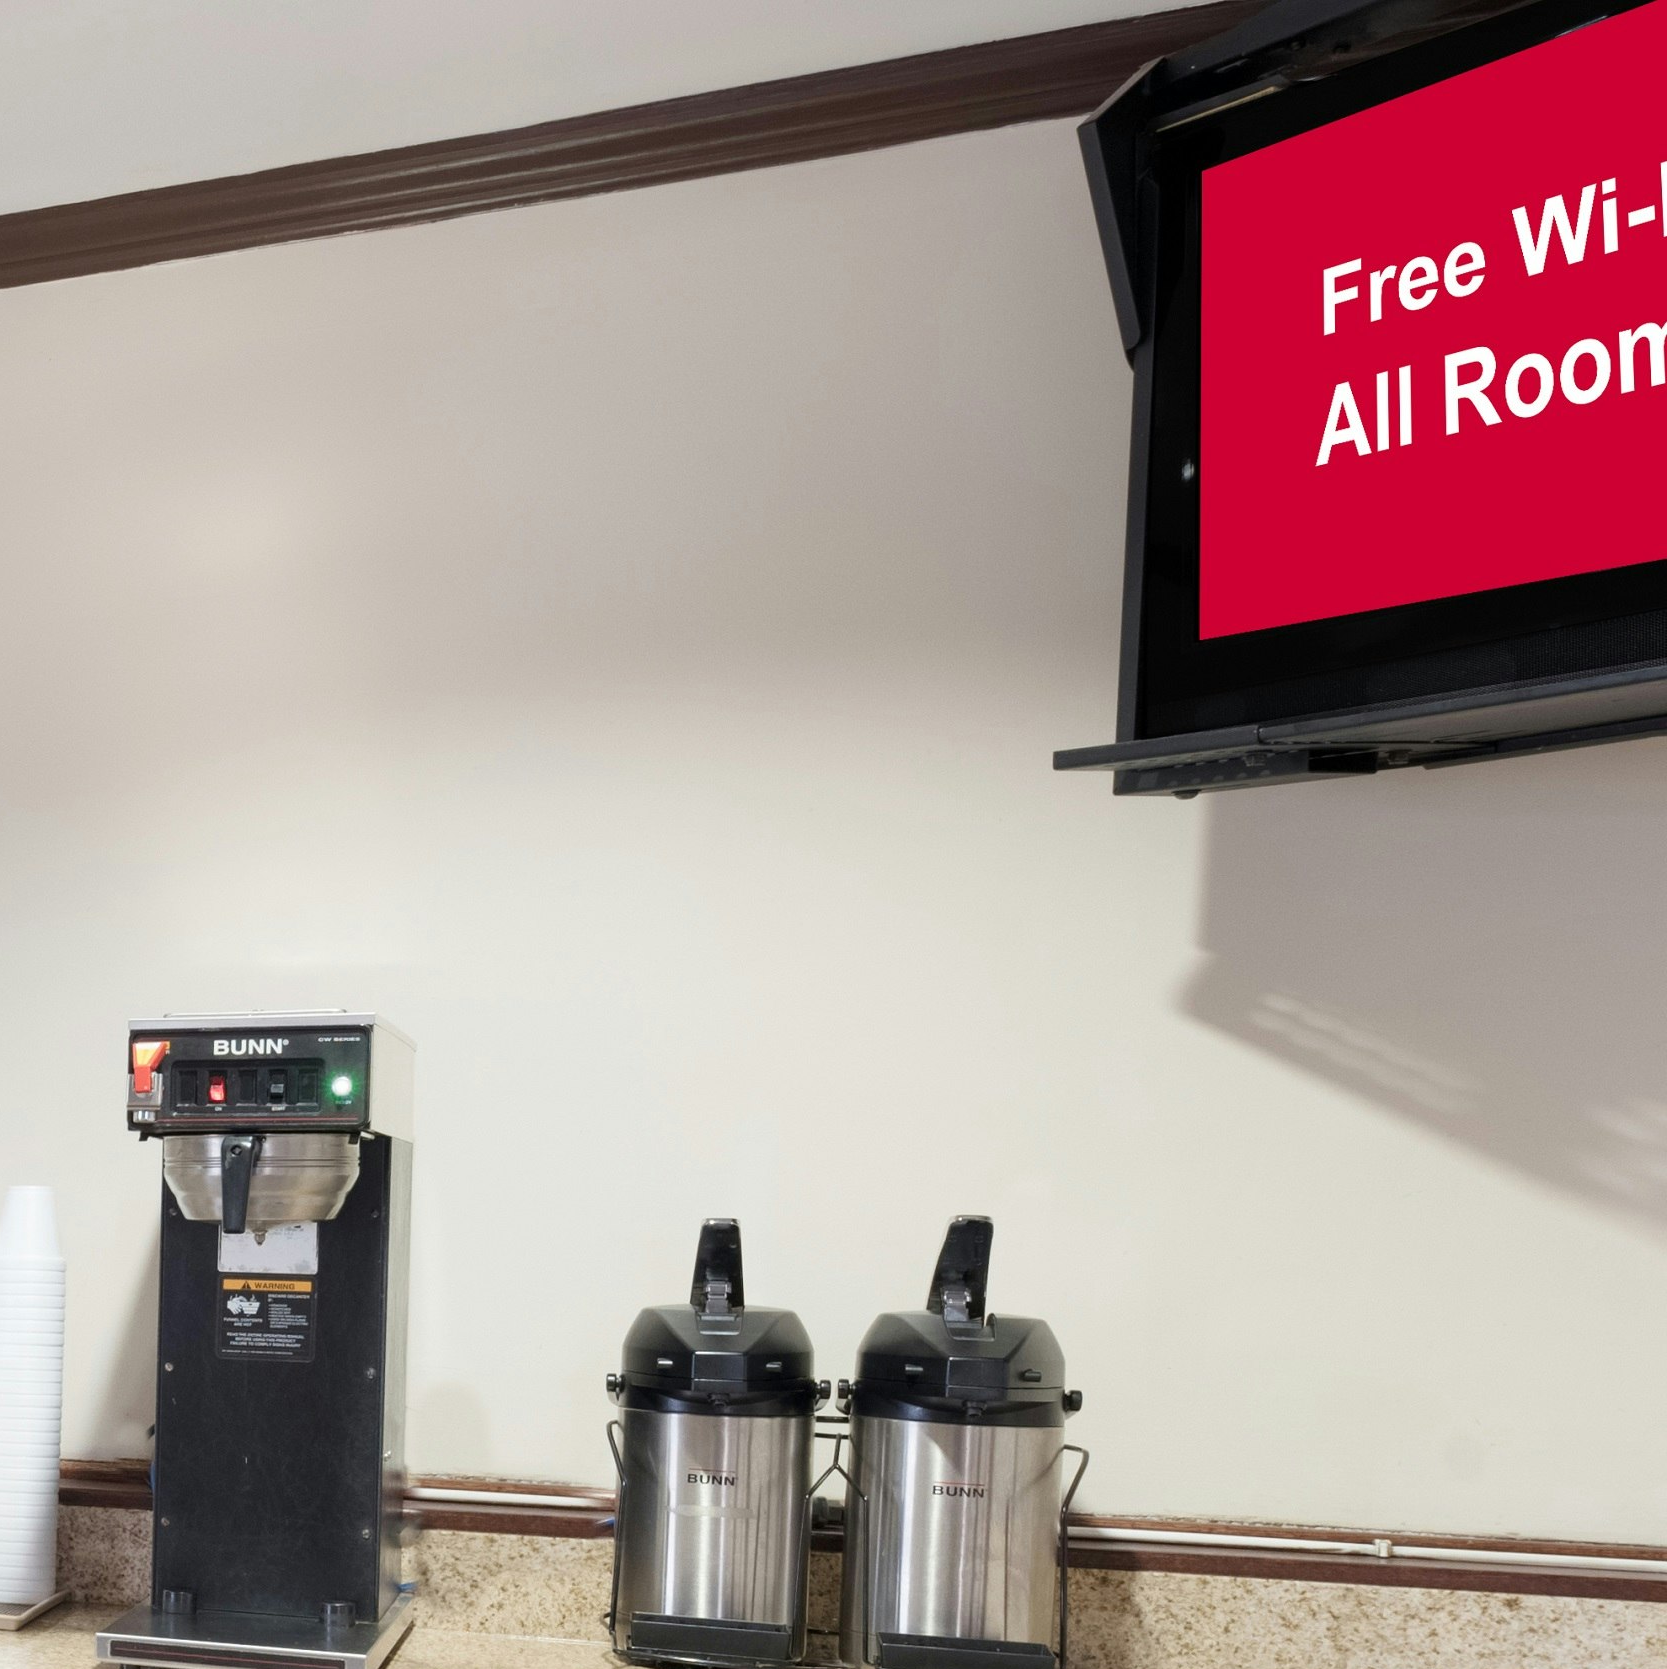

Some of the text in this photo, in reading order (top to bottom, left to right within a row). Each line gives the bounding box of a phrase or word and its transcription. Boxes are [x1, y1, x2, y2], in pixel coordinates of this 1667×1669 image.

[1324, 161, 1667, 335] Free Wi-
[1316, 365, 1412, 466] All
[213, 1038, 283, 1056] BUNN
[254, 1281, 296, 1290] WARNING
[687, 1473, 736, 1487] BUNN
[932, 1485, 985, 1498] BUNN
